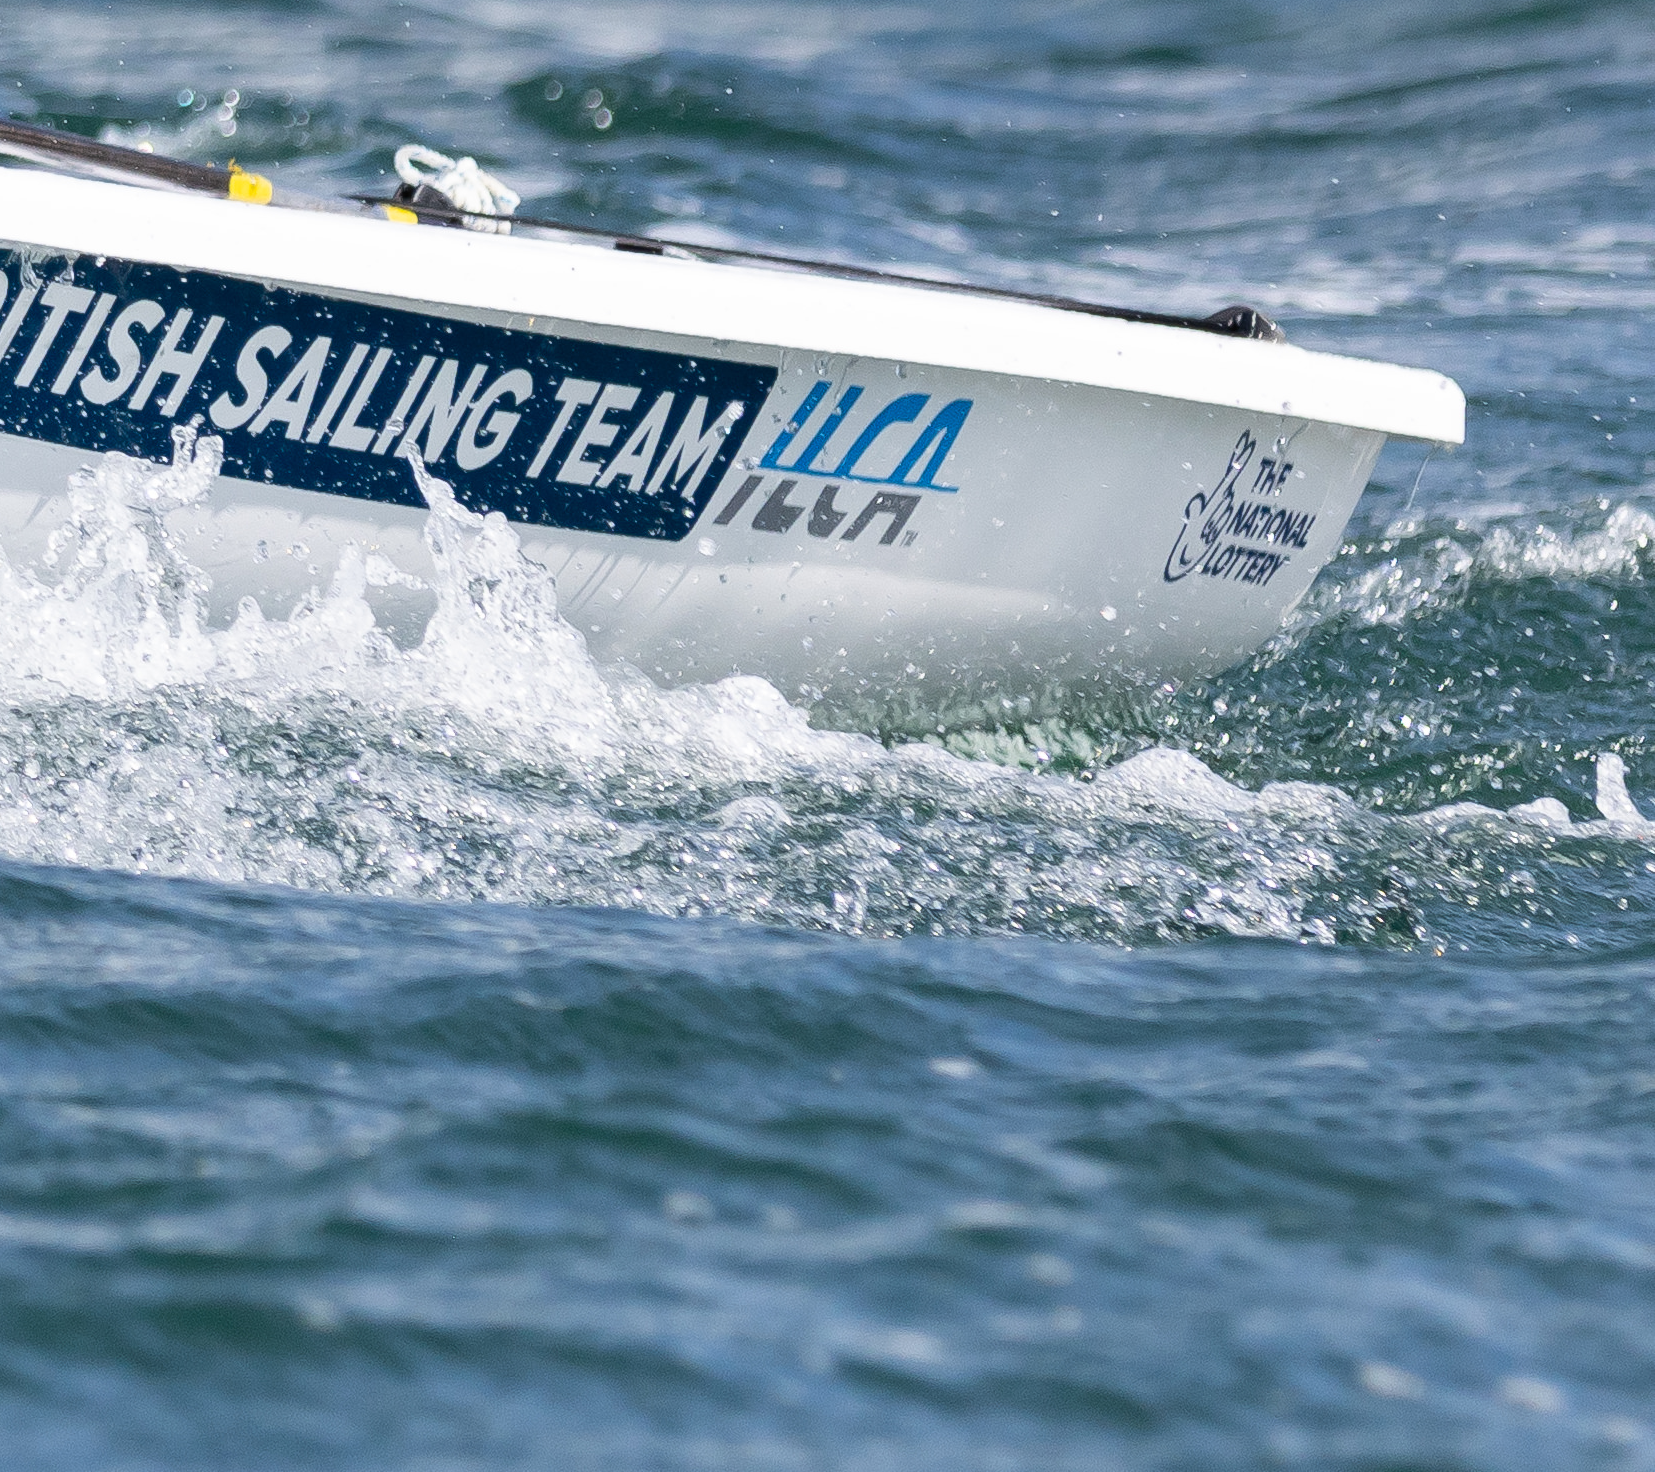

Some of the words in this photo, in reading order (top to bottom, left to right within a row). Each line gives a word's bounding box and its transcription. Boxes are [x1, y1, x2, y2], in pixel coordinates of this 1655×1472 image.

[208, 324, 534, 471] SAILING
[525, 376, 746, 501] TEAM
[1250, 456, 1295, 496] THE
[1225, 500, 1317, 550] NATIONAL
[1201, 542, 1291, 587] LOTTERY
